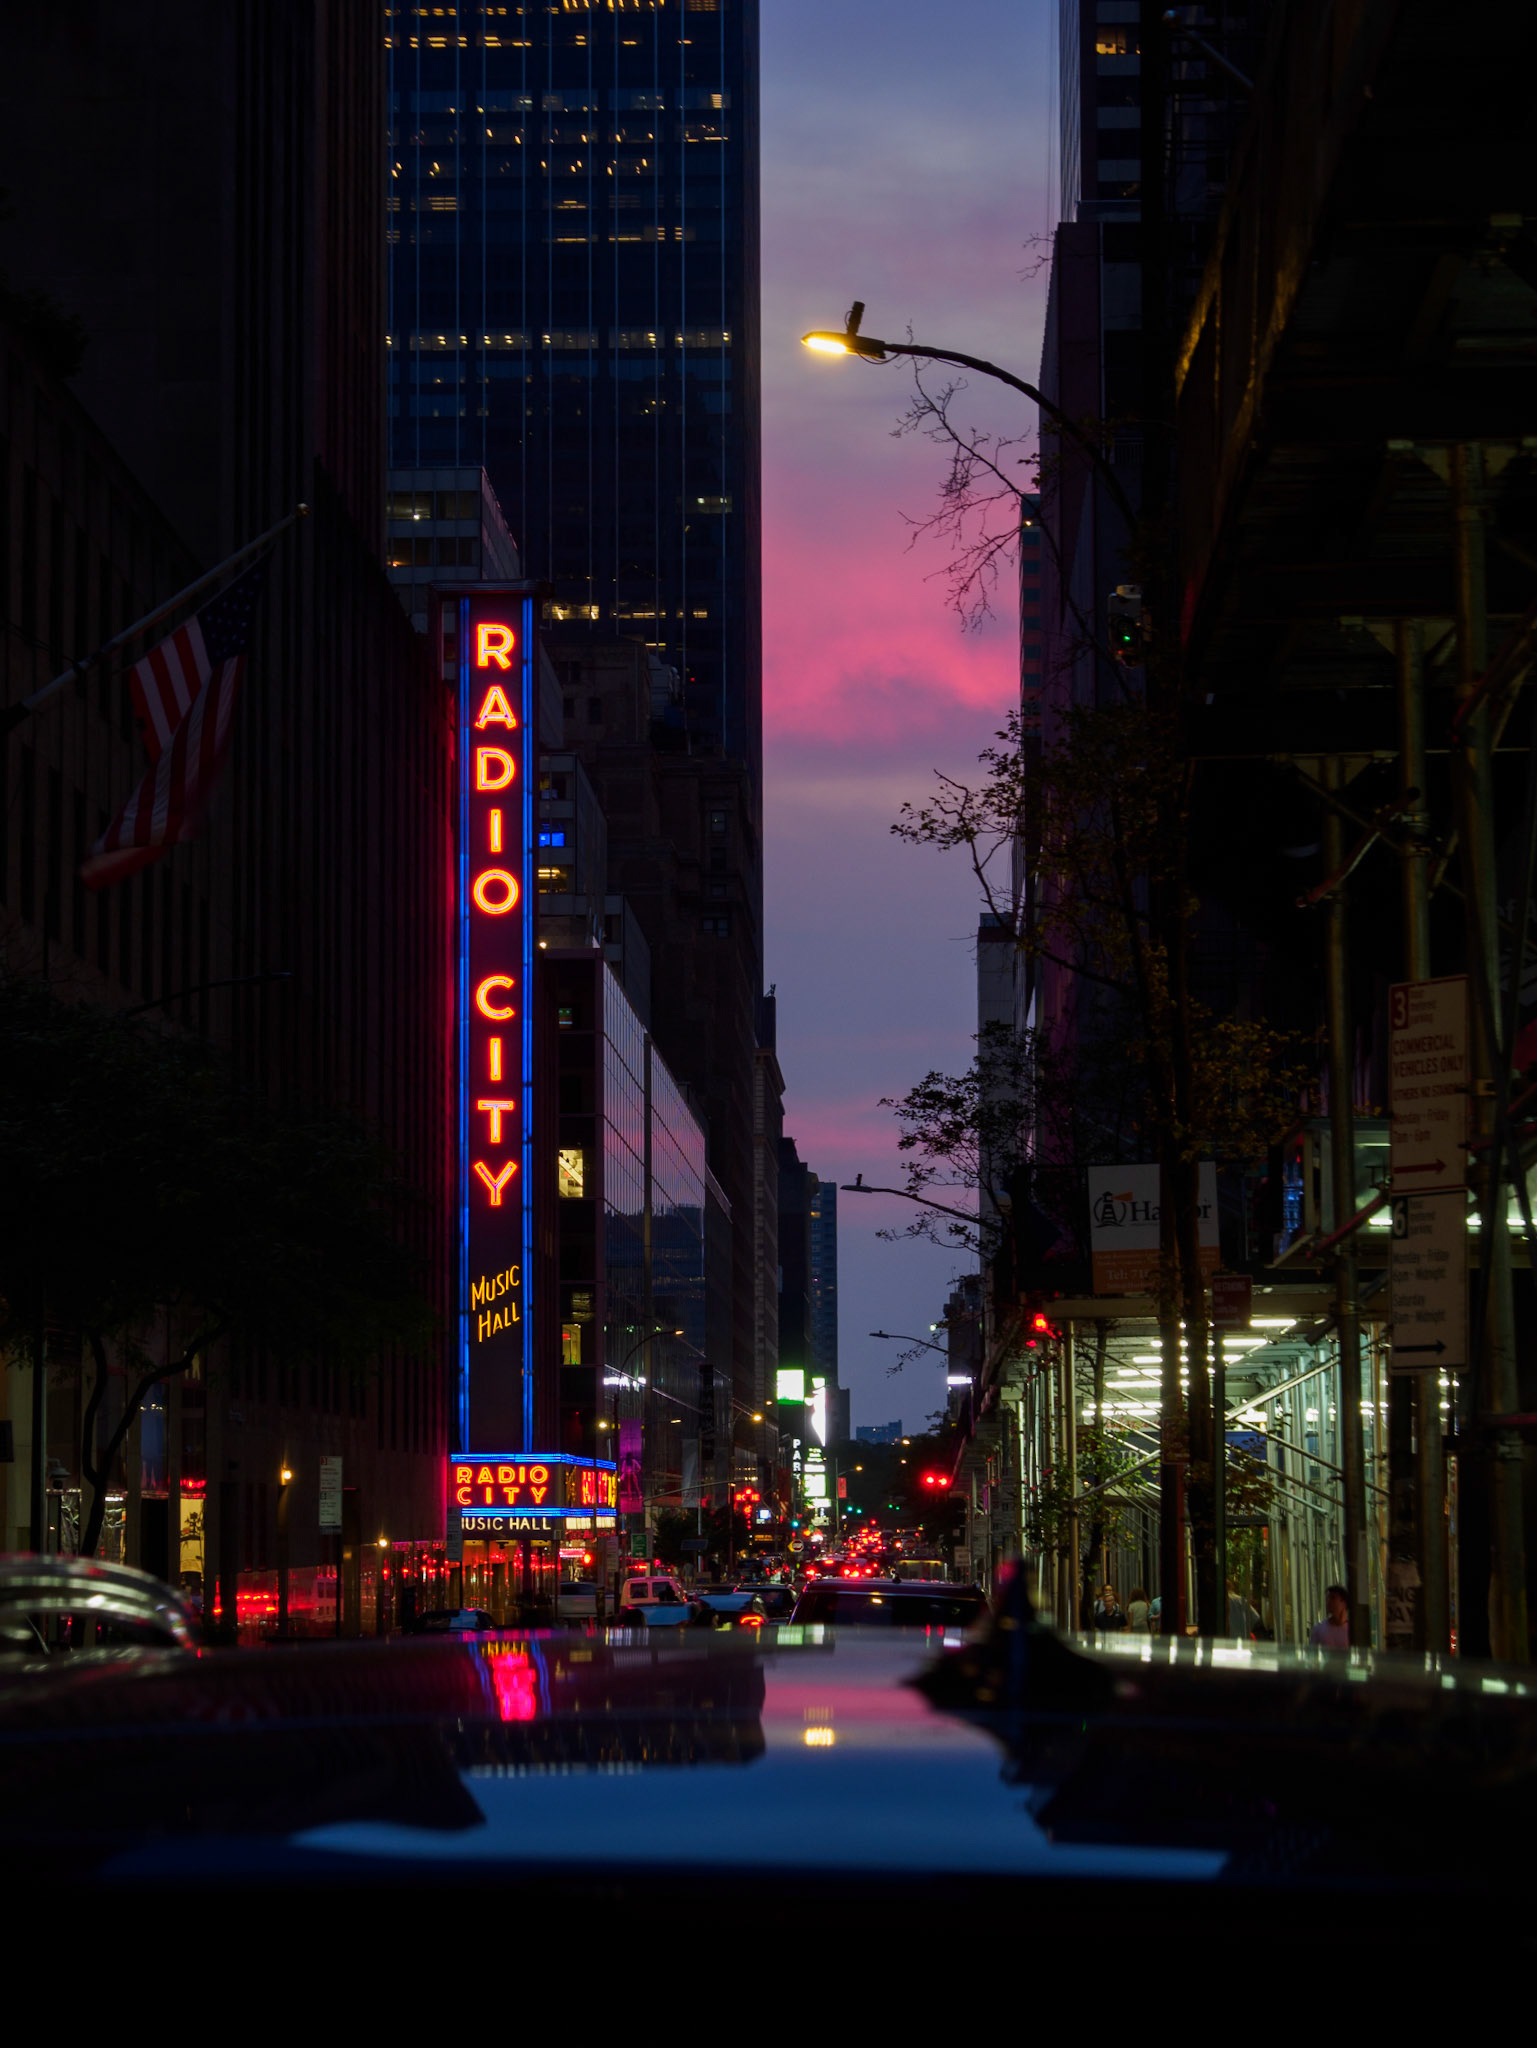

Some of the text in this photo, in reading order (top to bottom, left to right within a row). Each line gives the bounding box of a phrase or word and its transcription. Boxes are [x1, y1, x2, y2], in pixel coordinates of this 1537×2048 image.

[472, 622, 519, 915] RADIO
[1393, 991, 1407, 1027] 3
[1393, 1034, 1456, 1056] COMMERCIAL
[1393, 1054, 1464, 1078] VEHICLES ONLY
[473, 974, 518, 1206] CITY
[1130, 1199, 1212, 1222] Har
[1393, 1199, 1407, 1237] 6
[471, 1264, 520, 1311] MUSIC
[478, 1301, 521, 1343] HALL
[456, 1465, 549, 1485] RADIO
[456, 1486, 547, 1505] CITY
[509, 1516, 552, 1531] HALL
